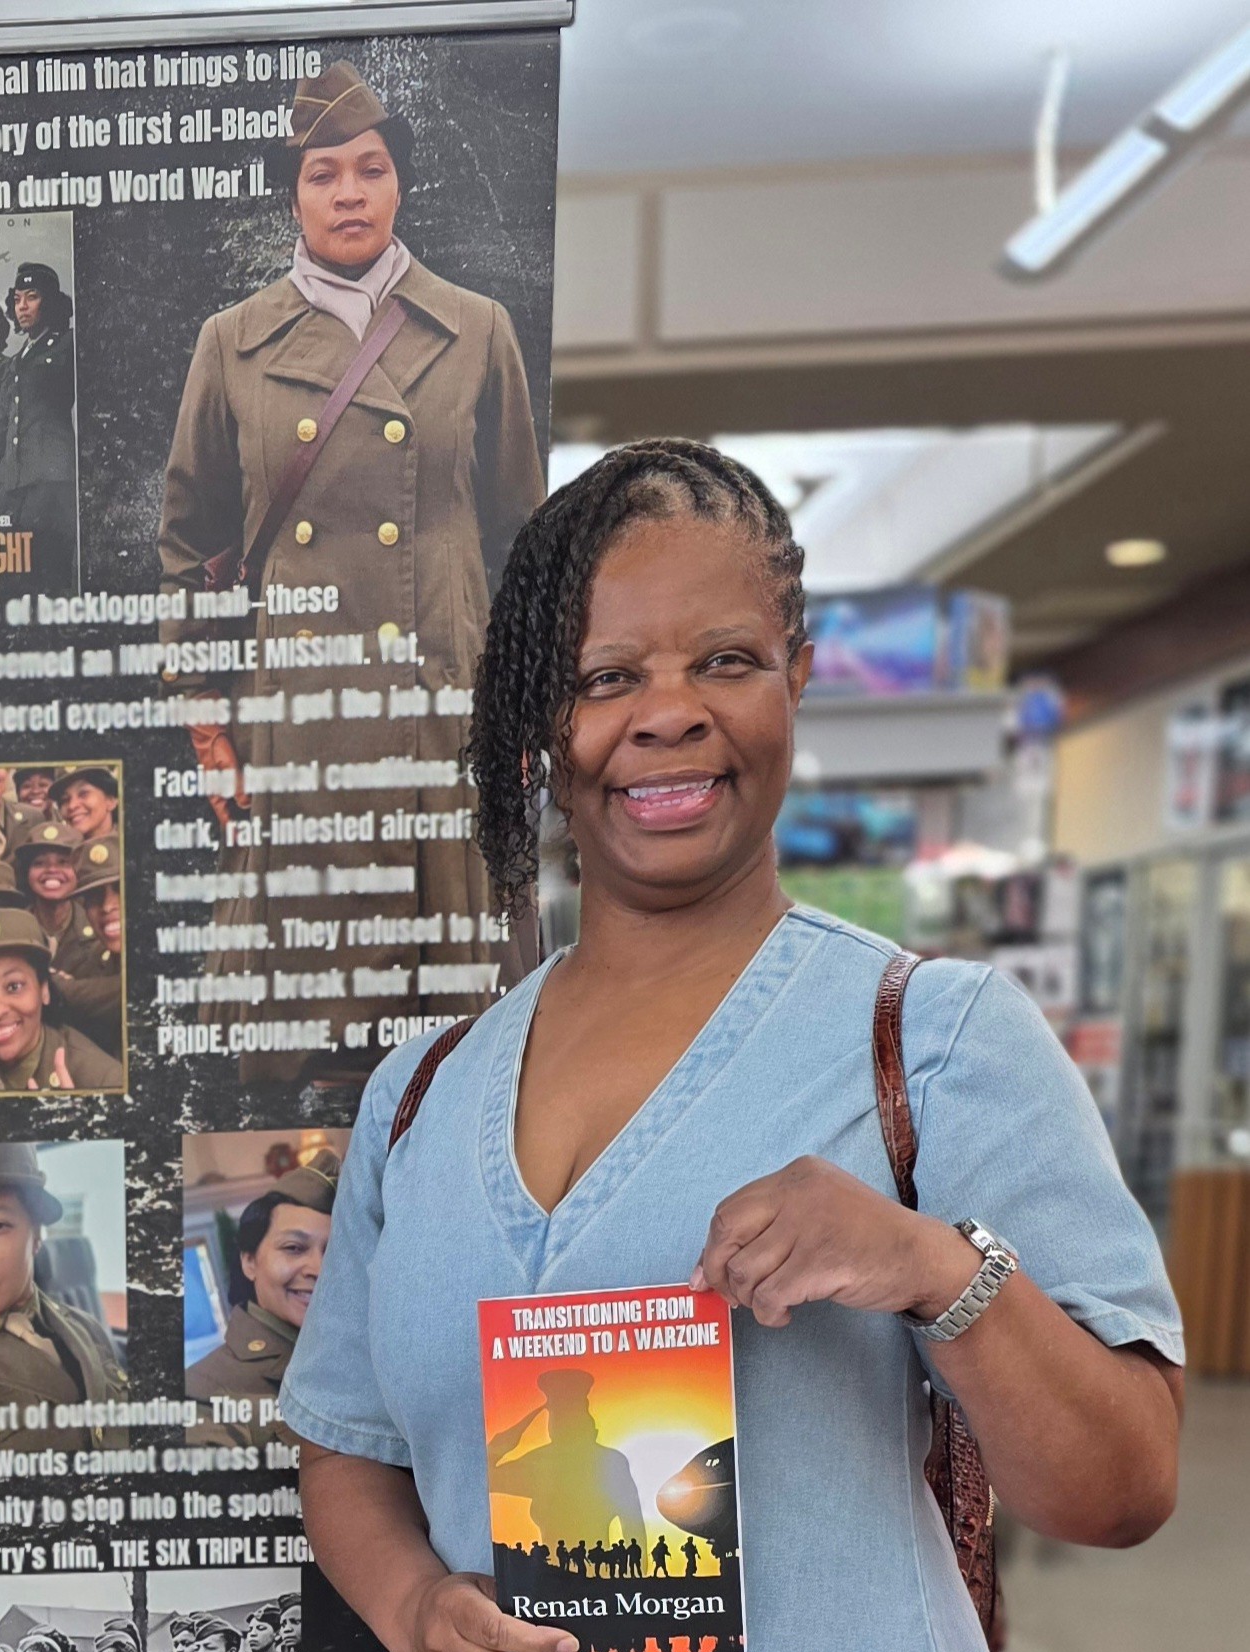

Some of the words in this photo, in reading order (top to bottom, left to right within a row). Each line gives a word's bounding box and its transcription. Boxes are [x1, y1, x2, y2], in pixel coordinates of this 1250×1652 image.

[36, 59, 85, 92] film
[94, 54, 146, 90] that
[154, 51, 238, 90] brings
[246, 50, 273, 82] to
[280, 45, 322, 79] life
[35, 115, 64, 149] of
[69, 113, 111, 148] the
[118, 111, 172, 145] first
[179, 104, 295, 142] all-Black
[19, 170, 101, 208] during
[109, 168, 184, 203] World
[192, 166, 243, 199] War
[250, 164, 272, 197] II.
[6, 594, 30, 626] of
[38, 589, 186, 625] backlogged
[82, 650, 112, 677] an
[120, 638, 256, 675] IMPOSSIBLE
[265, 634, 370, 669] MISSION.
[379, 631, 424, 667] Yet,
[67, 695, 230, 732] expectations
[155, 819, 219, 851] dark,
[226, 812, 374, 847] rat-infested
[282, 918, 340, 951] They
[348, 914, 442, 946] refused
[450, 913, 474, 942] to
[345, 1022, 372, 1048] or
[512, 1300, 642, 1331] TRANSITIONING
[646, 1296, 694, 1322] FROM
[492, 1340, 504, 1360] A
[508, 1332, 587, 1359] WEEKEND
[591, 1330, 613, 1354] TO
[618, 1329, 630, 1352] A
[634, 1322, 719, 1350] WARZONE
[26, 1402, 48, 1429] of
[55, 1399, 203, 1428] outstanding.
[210, 1396, 252, 1424] The
[75, 1446, 156, 1475] cannot
[163, 1446, 258, 1475] express
[42, 1496, 66, 1522] to
[71, 1494, 124, 1525] step
[131, 1492, 176, 1521] into
[184, 1490, 223, 1519] the
[53, 1542, 104, 1571] film,
[110, 1540, 149, 1568] THE
[156, 1539, 190, 1566] SIX
[197, 1536, 268, 1565] TRIPLE
[512, 1594, 608, 1619] Renata
[615, 1592, 725, 1623] Morgan
